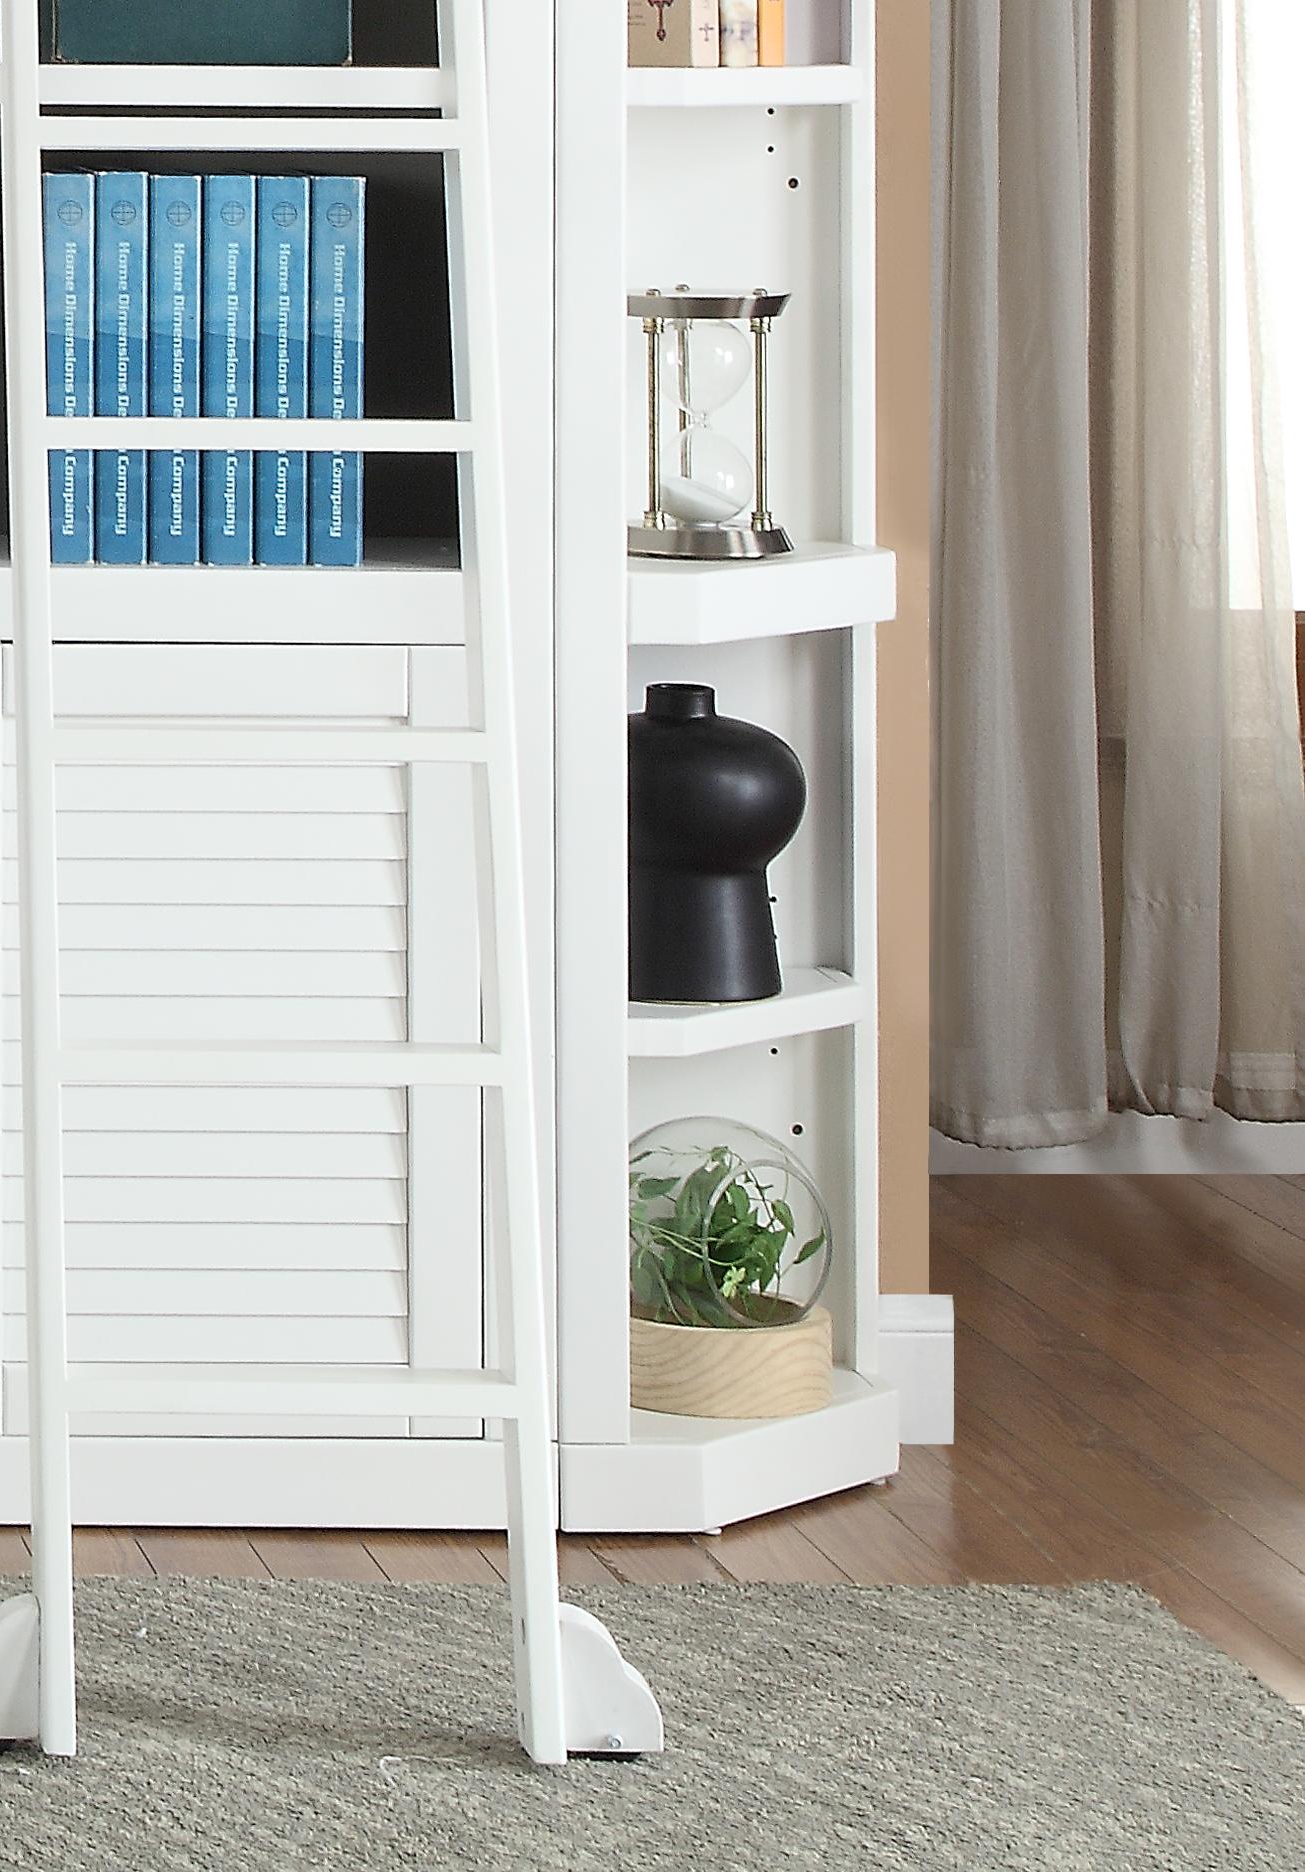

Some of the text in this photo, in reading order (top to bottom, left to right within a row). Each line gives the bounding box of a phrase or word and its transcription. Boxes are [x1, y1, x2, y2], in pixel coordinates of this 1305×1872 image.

[65, 242, 77, 291] Home
[119, 241, 131, 291] Home
[174, 242, 185, 292] Home
[228, 242, 239, 292] Home
[279, 243, 291, 293] Home
[334, 244, 346, 294] Home
[65, 294, 77, 393] Dimensions
[118, 294, 130, 393] Dimensions
[173, 295, 185, 394] Dimensions
[227, 295, 239, 394] Dimensions
[278, 295, 290, 394] Dimensions
[334, 296, 346, 395] Dimensions
[62, 456, 77, 536] Company
[115, 455, 130, 536] Company
[170, 456, 185, 536] Company
[223, 456, 237, 537] Company
[275, 457, 289, 537] Company
[330, 458, 345, 538] Company
